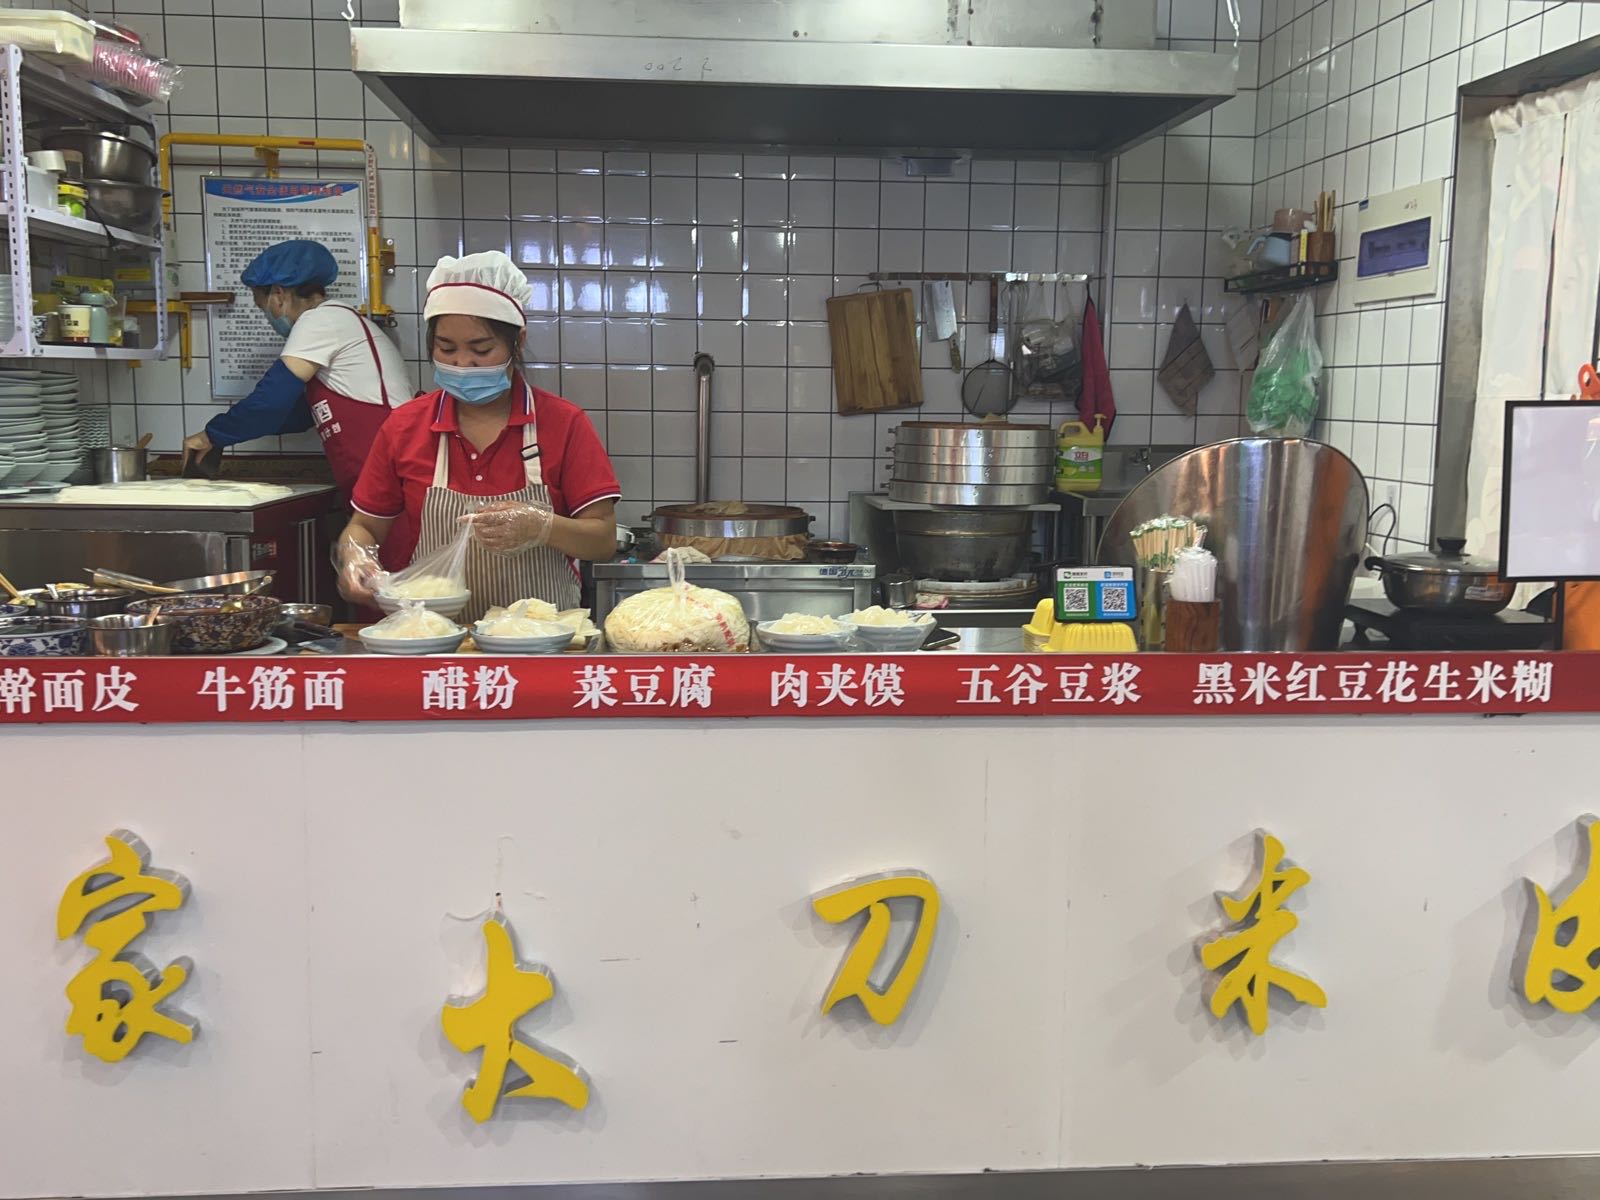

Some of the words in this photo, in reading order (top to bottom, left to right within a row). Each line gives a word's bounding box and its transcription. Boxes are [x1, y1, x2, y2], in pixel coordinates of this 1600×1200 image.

[197, 666, 346, 712] 牛筋面
[422, 665, 519, 711] 醋粉
[573, 663, 714, 710] 菜豆腐
[770, 662, 905, 708] 肉夹馍
[957, 662, 1142, 706] 五谷豆浆
[1192, 660, 1554, 705] 黑米红豆花生米糊
